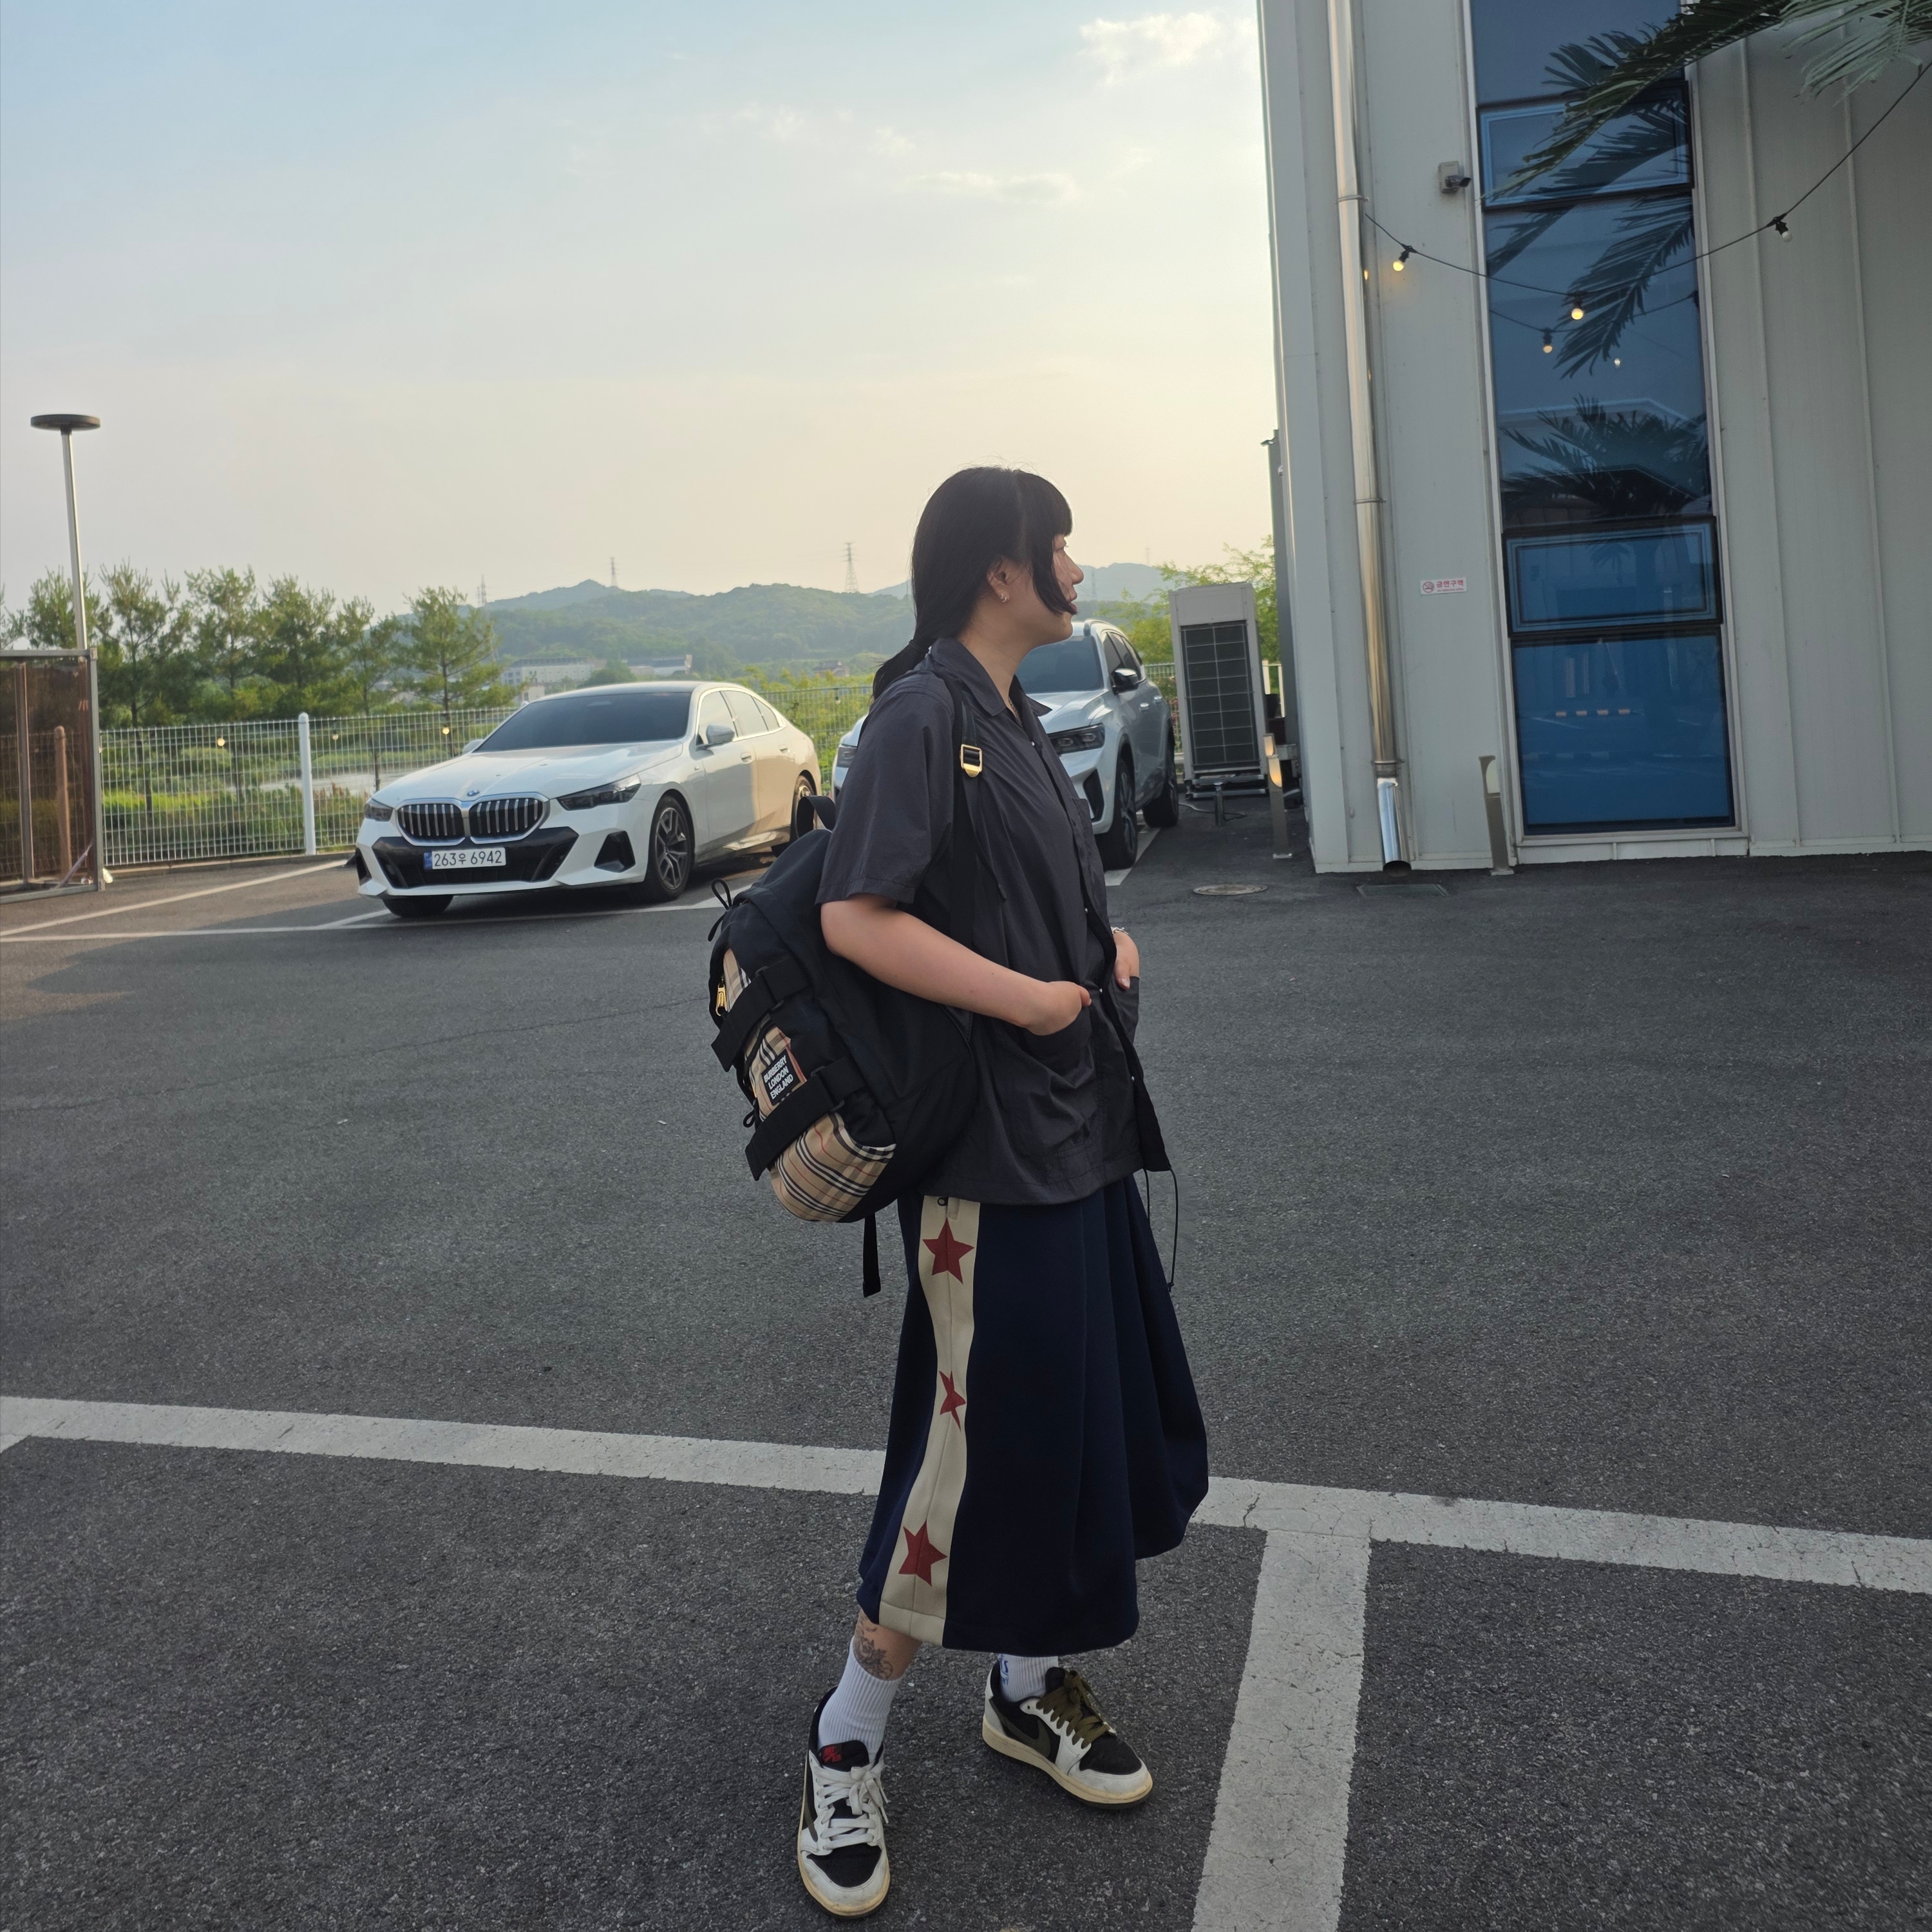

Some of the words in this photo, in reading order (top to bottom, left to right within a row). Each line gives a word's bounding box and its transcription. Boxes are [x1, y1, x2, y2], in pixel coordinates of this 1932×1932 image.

[1436, 580, 1464, 589] 금연구역
[434, 853, 466, 867] 263우
[470, 850, 502, 865] 6942
[763, 1054, 787, 1083] BURBERRY
[768, 1066, 790, 1090] LONDON
[770, 1074, 793, 1100] ENGLAND
